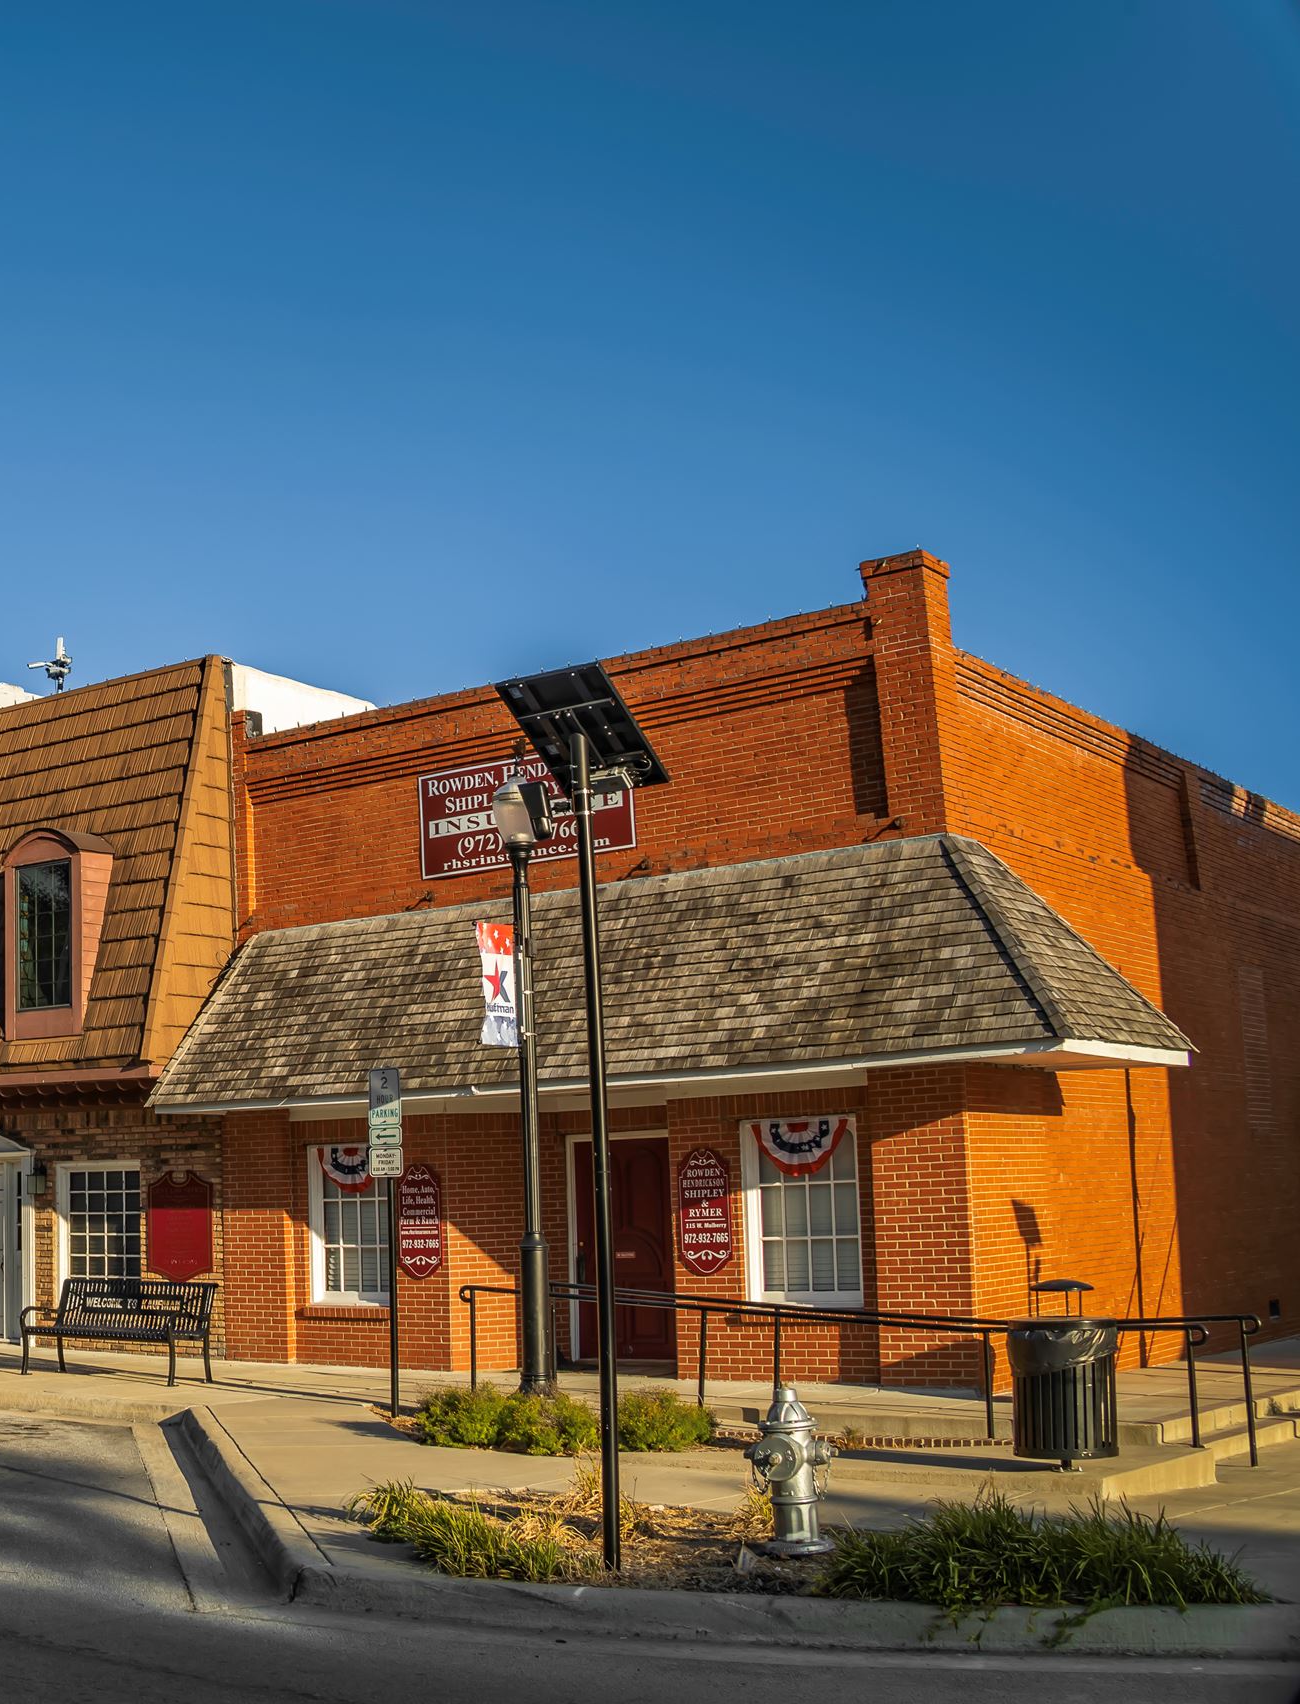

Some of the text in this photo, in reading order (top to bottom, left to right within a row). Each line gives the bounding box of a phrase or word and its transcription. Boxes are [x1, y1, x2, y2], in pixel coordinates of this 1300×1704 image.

[428, 771, 499, 798] ROWDEN,
[445, 793, 493, 814] SHIPL
[457, 832, 503, 858] (972)
[380, 1076, 389, 1090] 2
[376, 1094, 394, 1105] HOUR
[371, 1108, 399, 1119] PARKING
[686, 1168, 721, 1178] ROWDEN
[682, 1178, 725, 1188] HENDRICKSON
[402, 1185, 435, 1195] Home, Auto,
[684, 1188, 725, 1199] SHIPLEY
[402, 1196, 436, 1206] Life, Health,
[701, 1199, 709, 1208] &
[402, 1207, 436, 1216] Commercial
[688, 1207, 723, 1217] RYMER
[400, 1217, 415, 1225] Farm
[421, 1216, 439, 1225] Ranch
[684, 1232, 729, 1244] 972-932-7665
[402, 1239, 440, 1249] 972-932-7665
[86, 1296, 123, 1309] WELCOME
[140, 1299, 180, 1312] KAUFMAN
